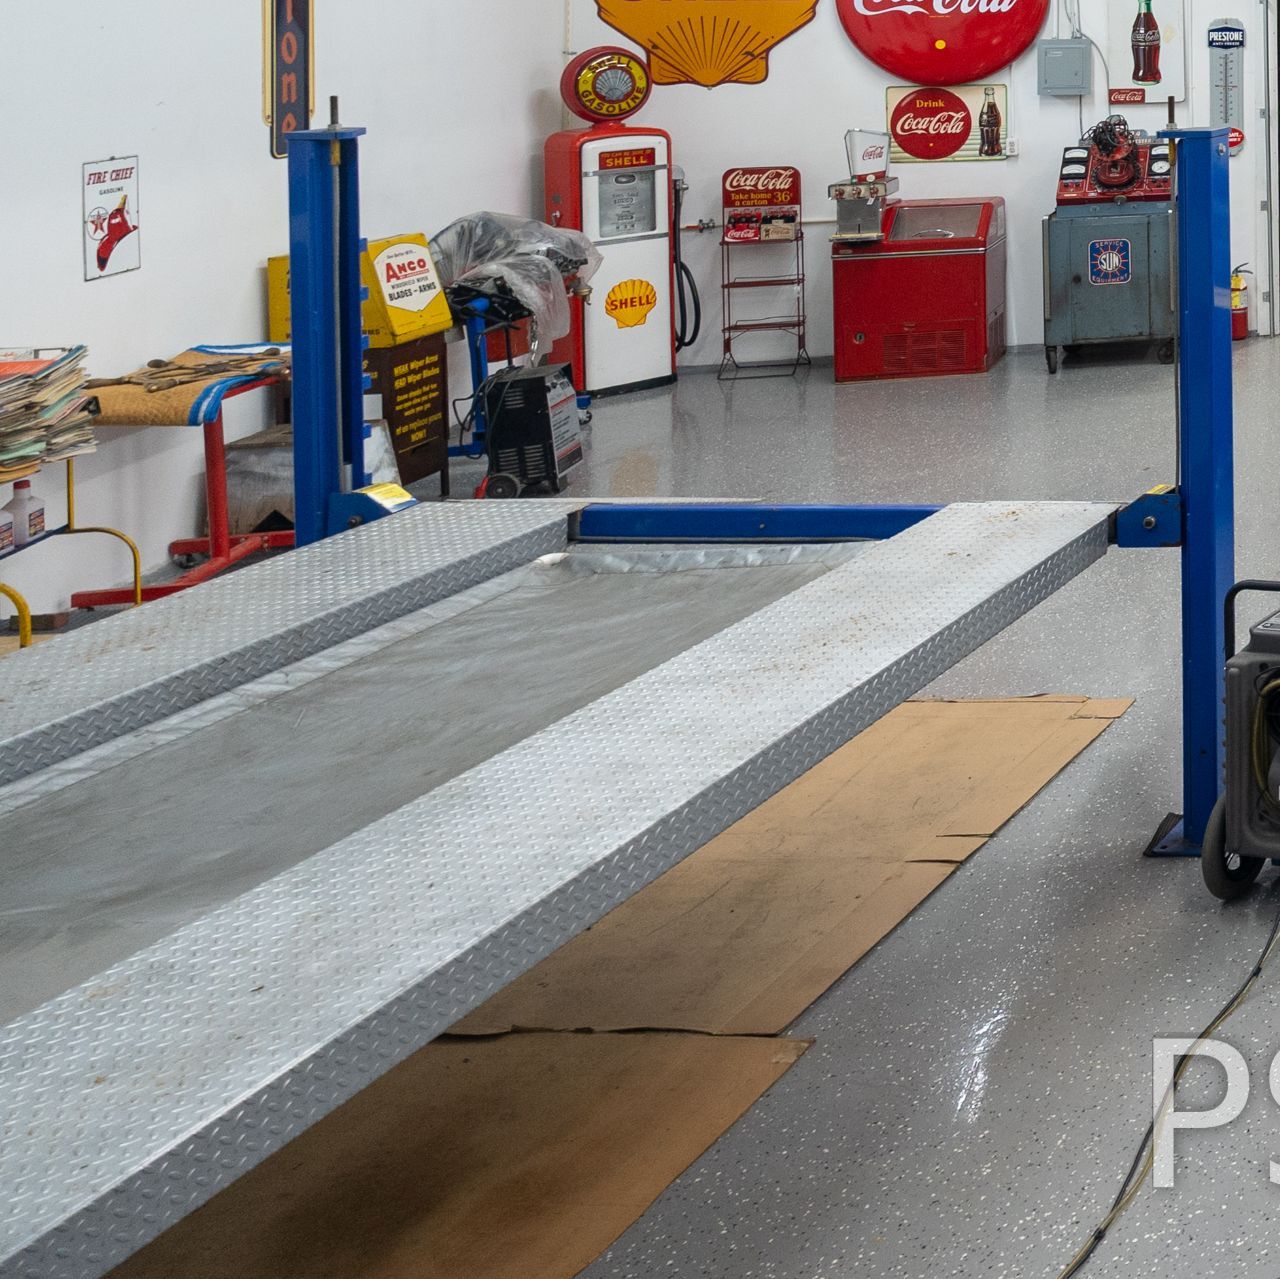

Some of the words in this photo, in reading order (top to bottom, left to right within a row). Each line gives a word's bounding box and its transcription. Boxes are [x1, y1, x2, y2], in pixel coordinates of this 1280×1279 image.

[1209, 31, 1243, 41] PRESTONE
[588, 56, 633, 74] SHELL
[581, 86, 645, 114] GASOLINE
[916, 99, 945, 108] Drink
[1110, 91, 1144, 102] Coca-Cola
[896, 111, 968, 136] Coca-Cola
[606, 155, 648, 168] SHELL
[861, 145, 885, 161] Coca-Cola
[87, 171, 109, 186] FIRE
[110, 167, 135, 182] CHIEF
[725, 169, 796, 191] Coca-Cola
[99, 186, 124, 195] GASOLINE
[731, 192, 750, 200] Take
[751, 192, 772, 200] home
[1100, 252, 1120, 271] SUN
[385, 258, 427, 284] ANCO
[388, 288, 413, 302] BLADES
[418, 281, 437, 294] ARMS
[610, 294, 653, 311] SHELL
